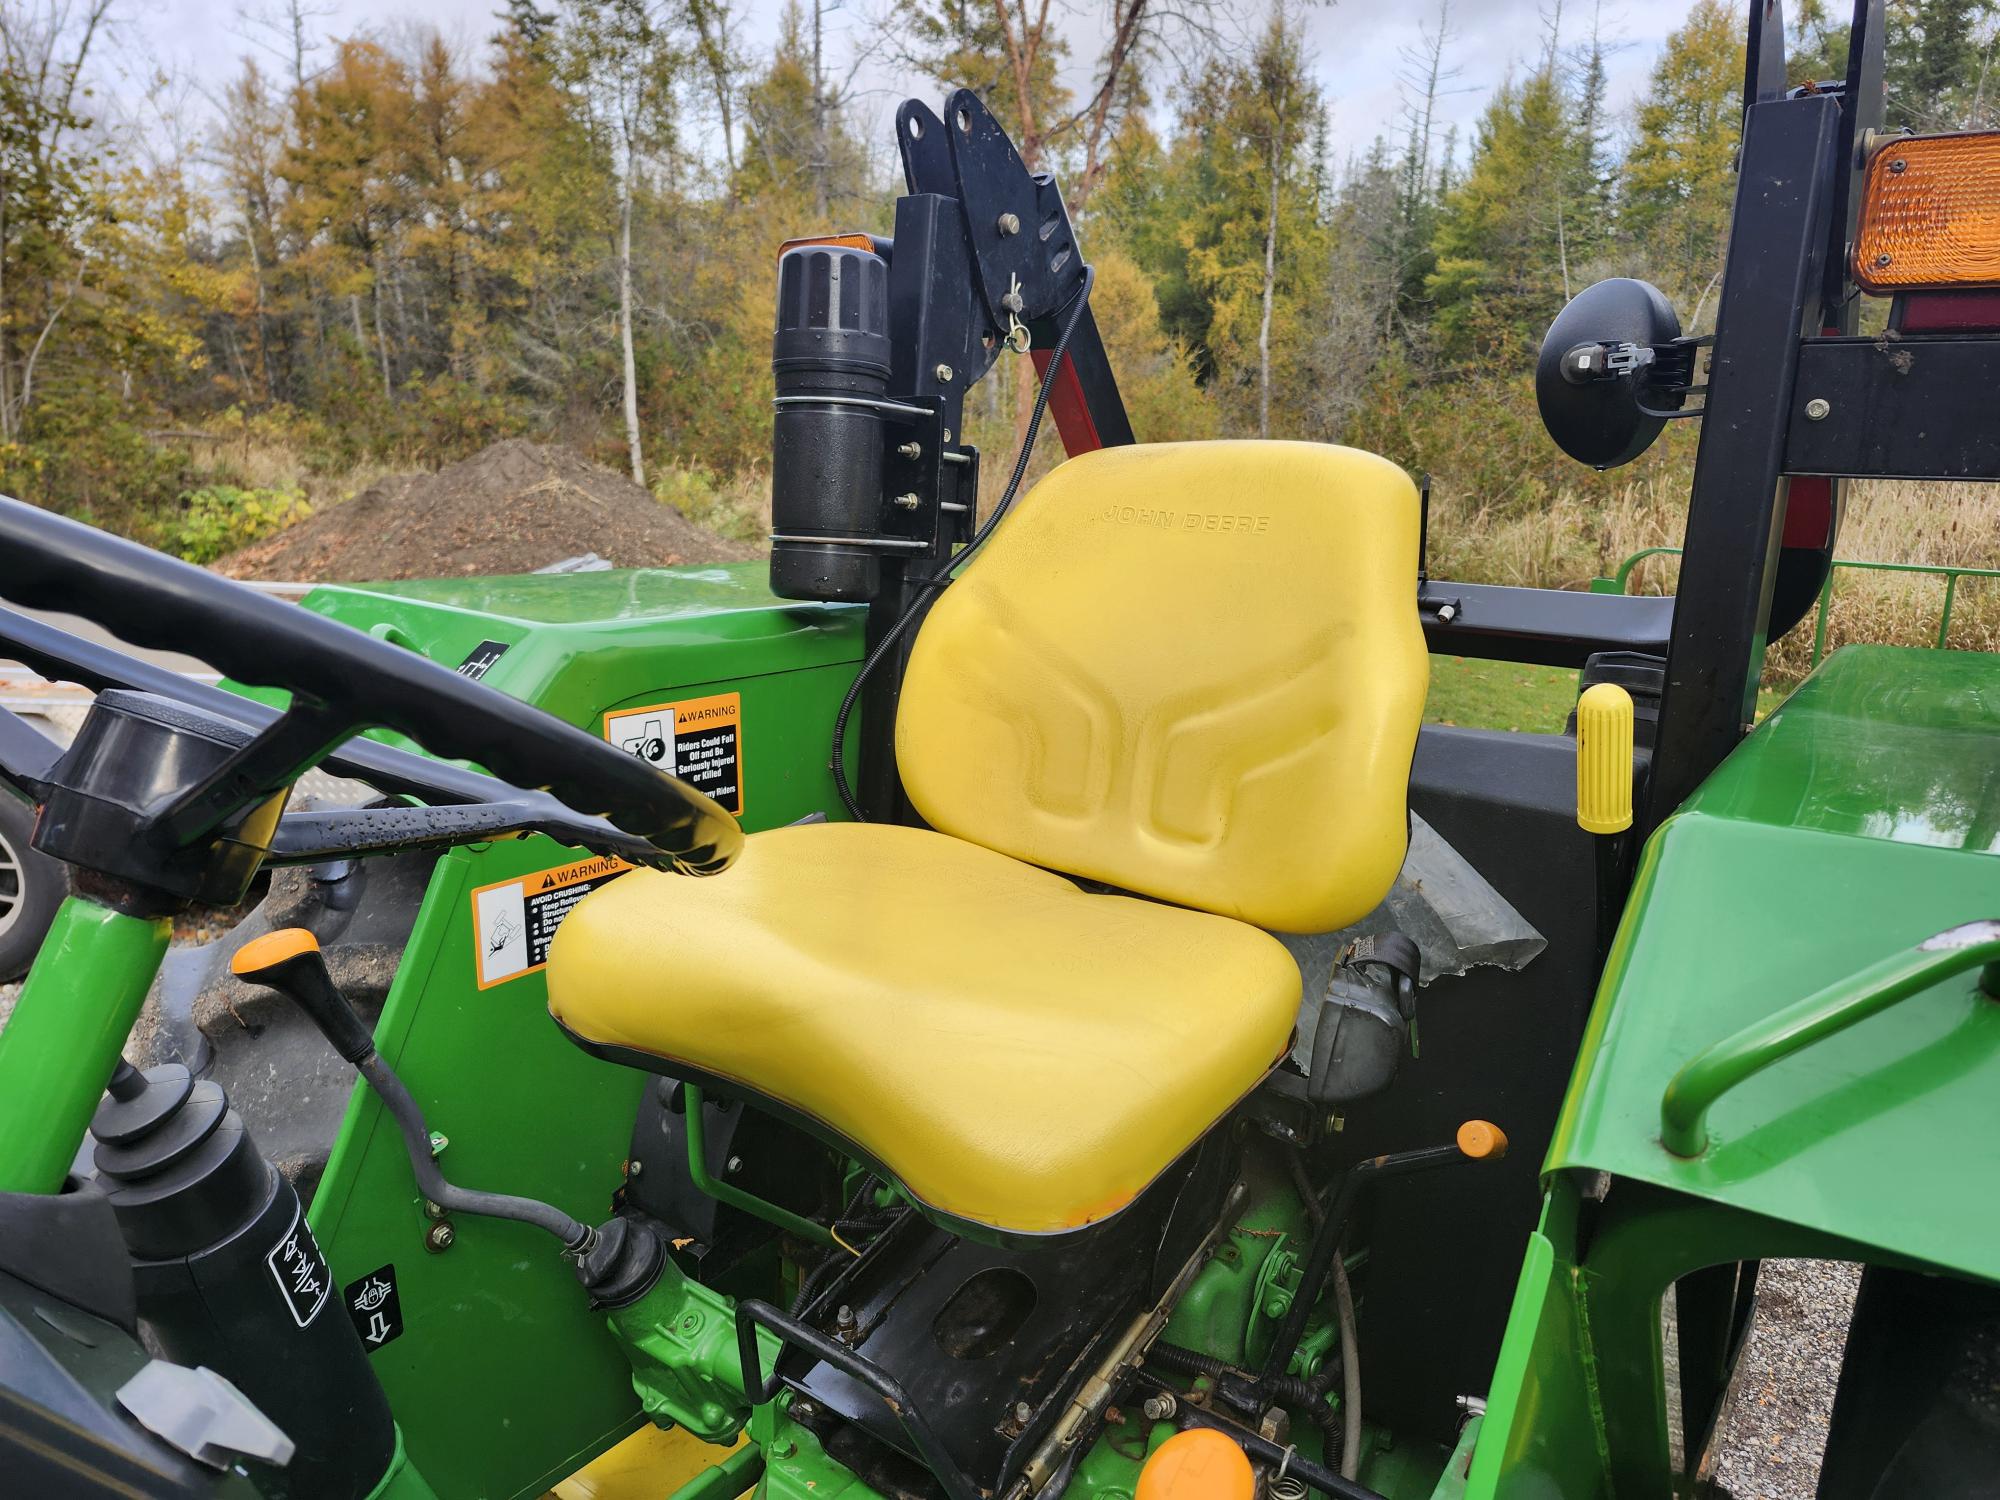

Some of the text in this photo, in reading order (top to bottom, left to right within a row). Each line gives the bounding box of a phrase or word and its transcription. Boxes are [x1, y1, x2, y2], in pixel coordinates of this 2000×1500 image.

[1102, 505, 1270, 535] JOHN DEERE
[688, 705, 736, 722] WARNING
[677, 733, 734, 752] Riders Could Fall
[689, 747, 724, 761] Off and Be
[678, 755, 735, 774] Seriously Injured
[693, 768, 721, 782] or Killed
[716, 785, 736, 796] Riders
[557, 858, 618, 882] WARNING
[531, 884, 591, 906] AVOID CRUSHING:
[542, 902, 560, 912] Keep
[543, 925, 556, 934] Use
[533, 935, 552, 946] When
